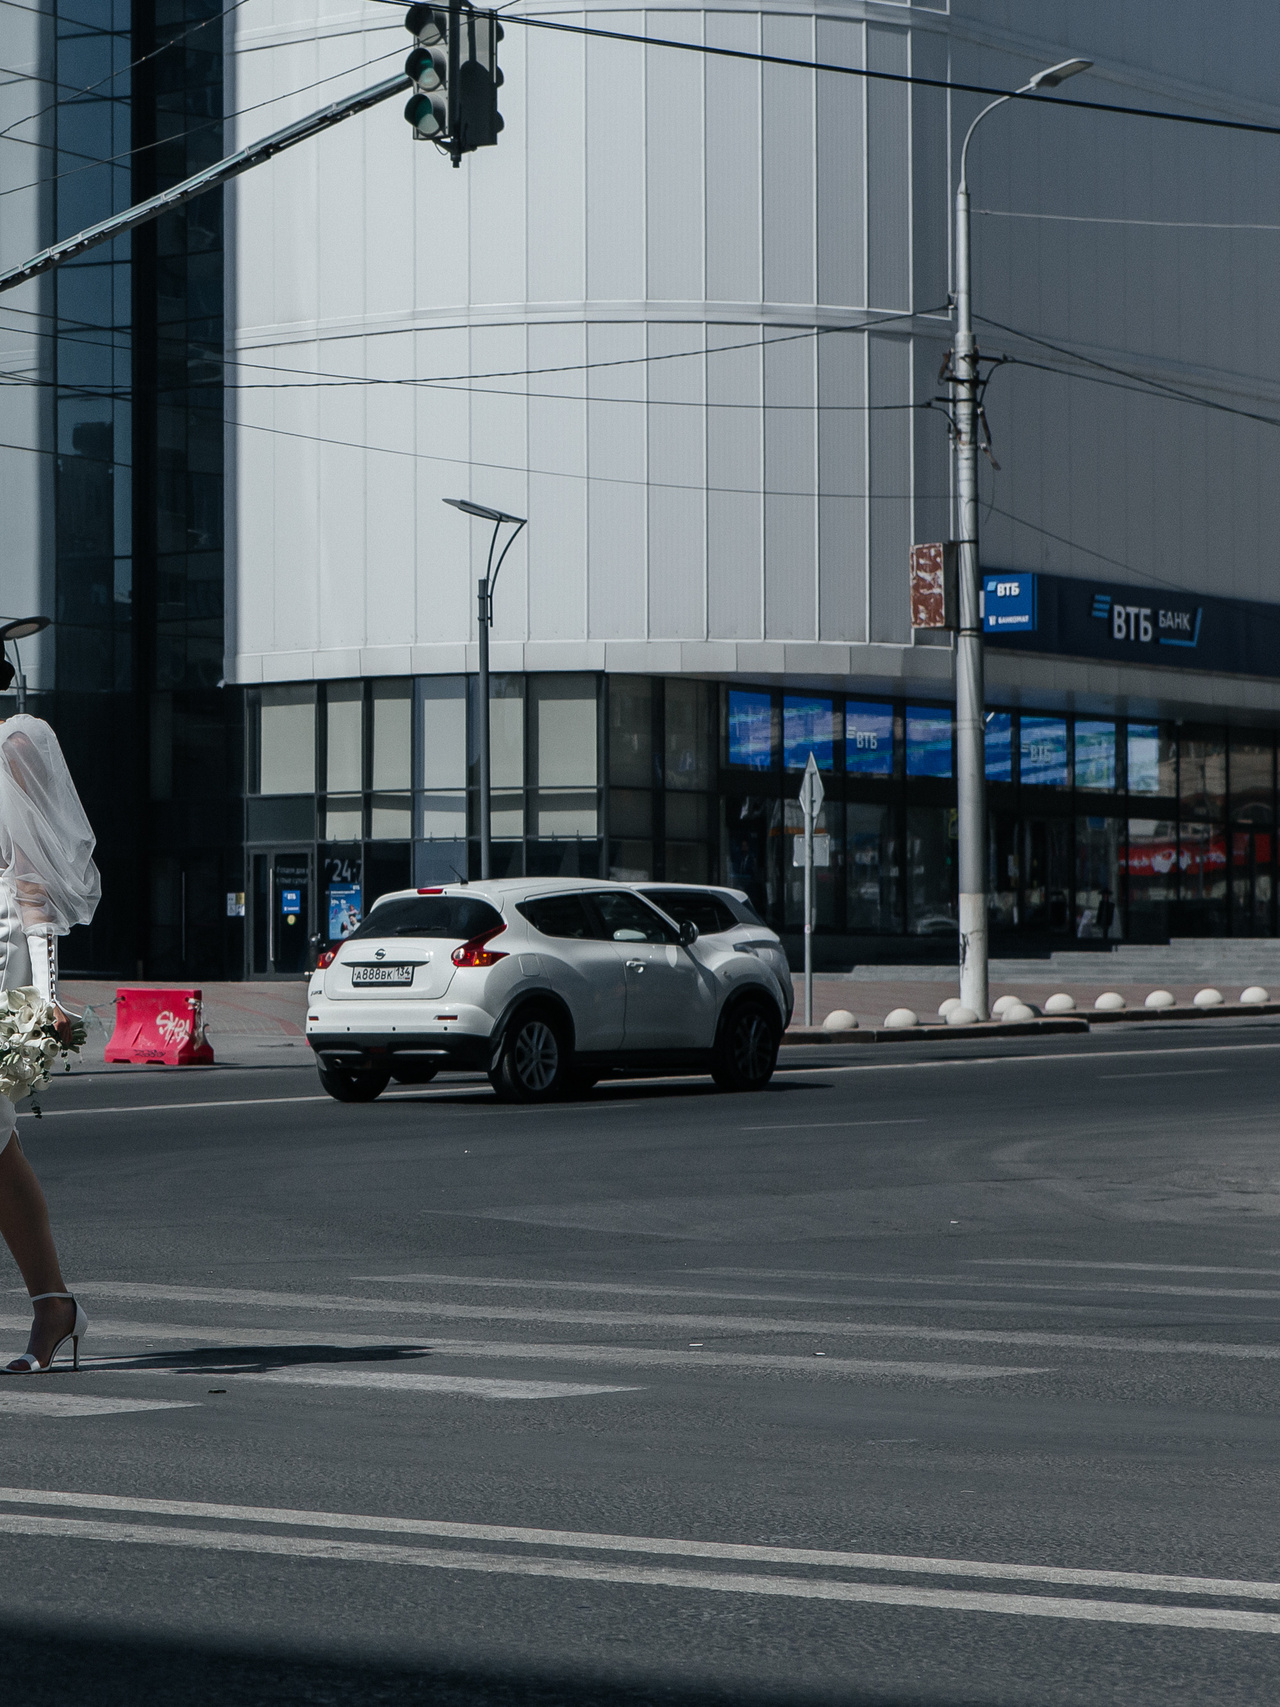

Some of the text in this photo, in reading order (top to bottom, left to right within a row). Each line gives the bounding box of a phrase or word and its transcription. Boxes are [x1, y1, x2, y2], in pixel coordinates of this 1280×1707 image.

[996, 582, 1020, 597] ВТБ
[1113, 604, 1191, 642] ВТБ БАНК
[856, 731, 877, 749] ВТБ
[1030, 745, 1052, 763] ВТБ
[356, 966, 411, 980] А888ВК 134
